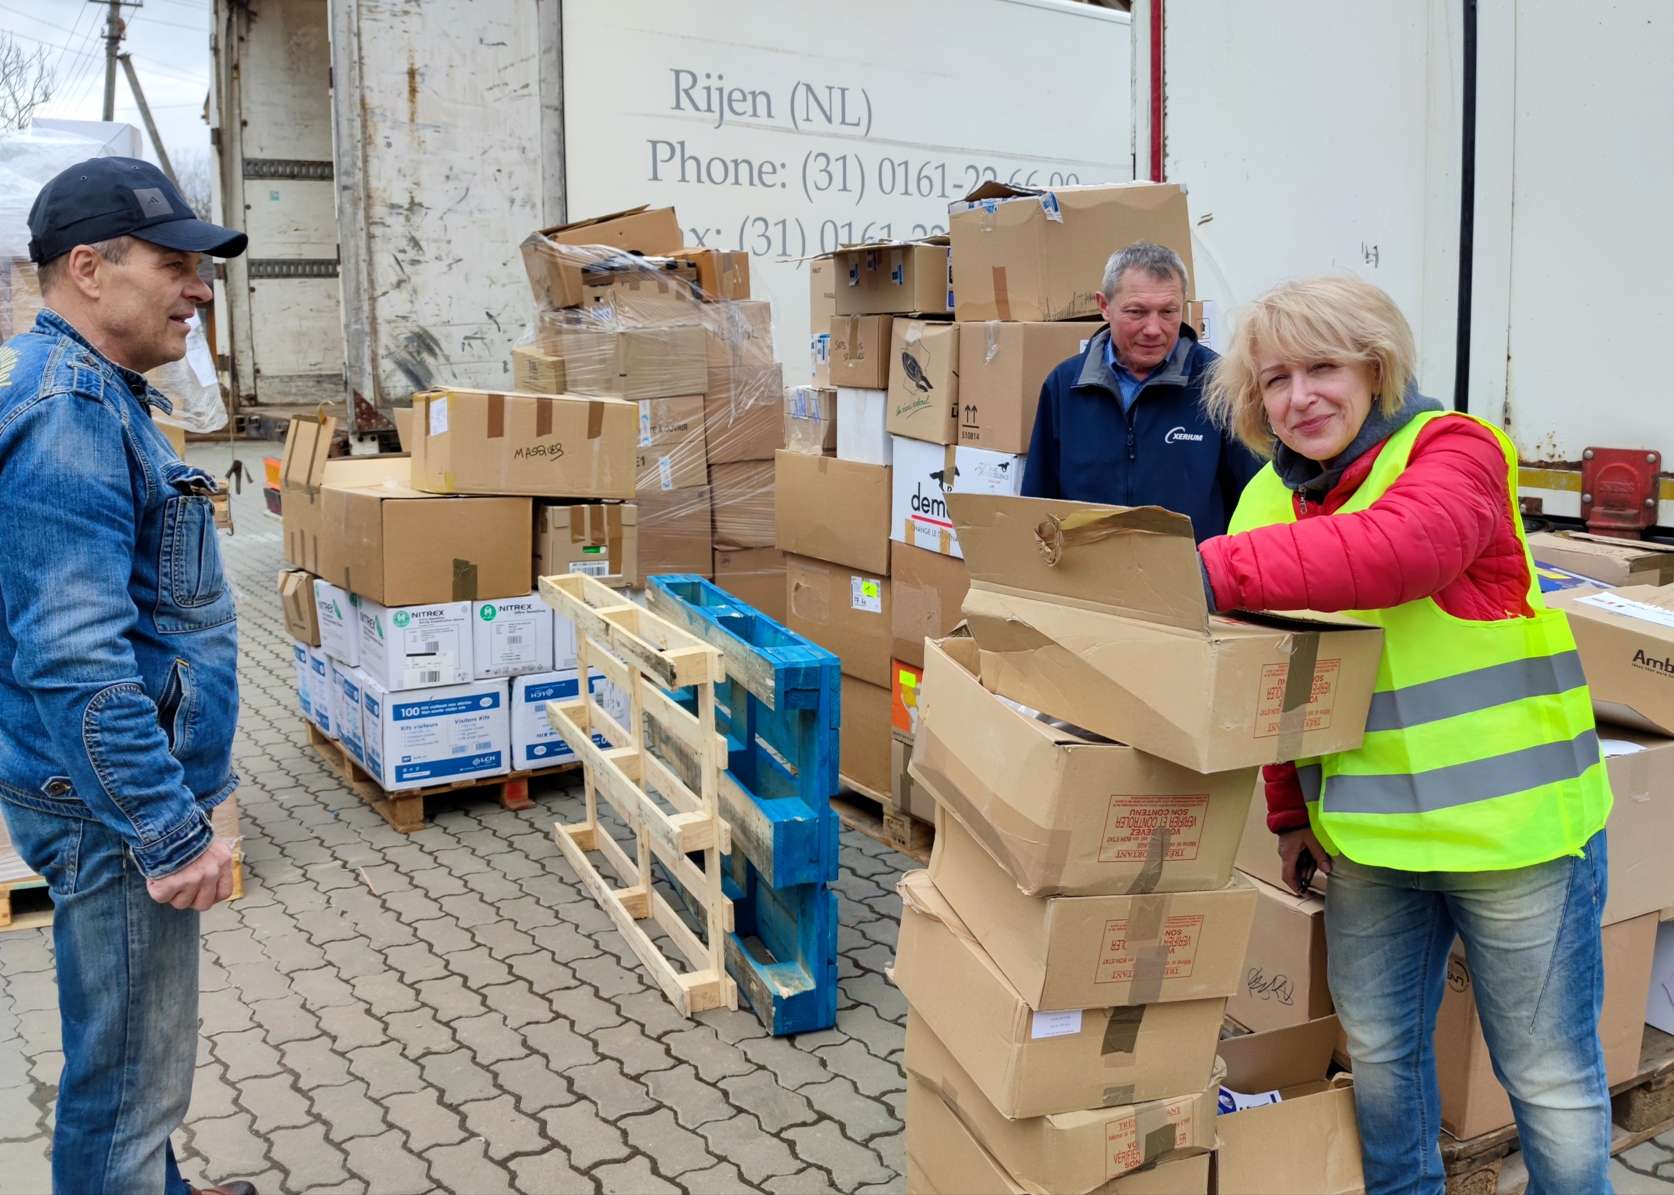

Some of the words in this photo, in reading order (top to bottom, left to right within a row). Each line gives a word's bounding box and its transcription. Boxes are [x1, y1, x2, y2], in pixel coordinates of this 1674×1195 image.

[669, 68, 775, 129] Rijen
[790, 81, 873, 137] (NL)
[647, 139, 787, 189] Phone:
[802, 150, 865, 206] (31)
[740, 216, 806, 270] (31)
[499, 604, 533, 612] NITREX
[411, 610, 445, 618] NITREX
[400, 707, 420, 717] 100
[1129, 808, 1170, 816] CONTENU
[1171, 808, 1189, 816] SON
[1129, 828, 1151, 836] EVEZ
[1165, 929, 1183, 937] SON
